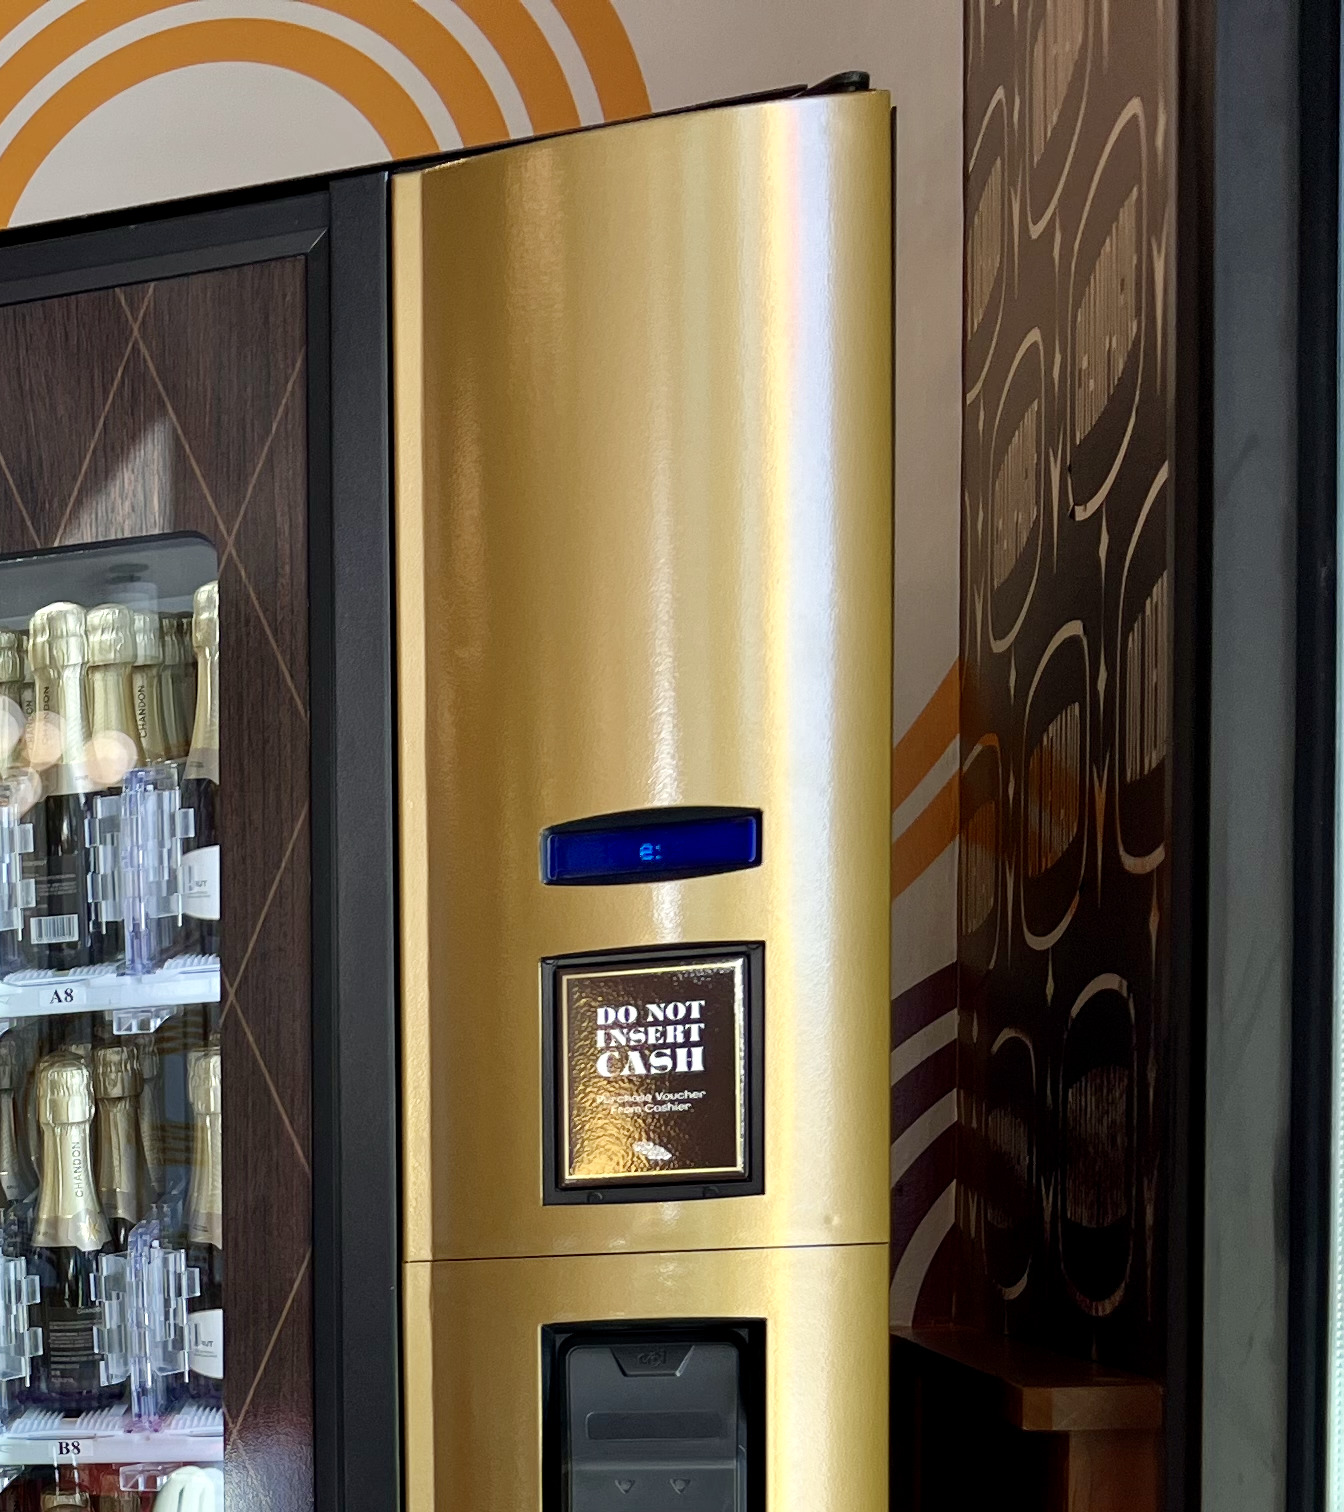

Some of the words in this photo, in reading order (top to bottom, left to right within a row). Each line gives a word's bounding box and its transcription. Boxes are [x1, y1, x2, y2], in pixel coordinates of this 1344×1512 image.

[41, 685, 51, 746] CHANDON
[137, 684, 148, 739] CHANDON
[49, 987, 75, 1004] A8
[596, 1005, 638, 1026] DO
[645, 1000, 706, 1022] NOT
[596, 1023, 706, 1048] INSERT
[596, 1046, 705, 1078] CASH
[655, 1089, 707, 1101] Voucher
[611, 1104, 642, 1115] From
[72, 1141, 84, 1199] CHANDON
[57, 1440, 81, 1456] B8
